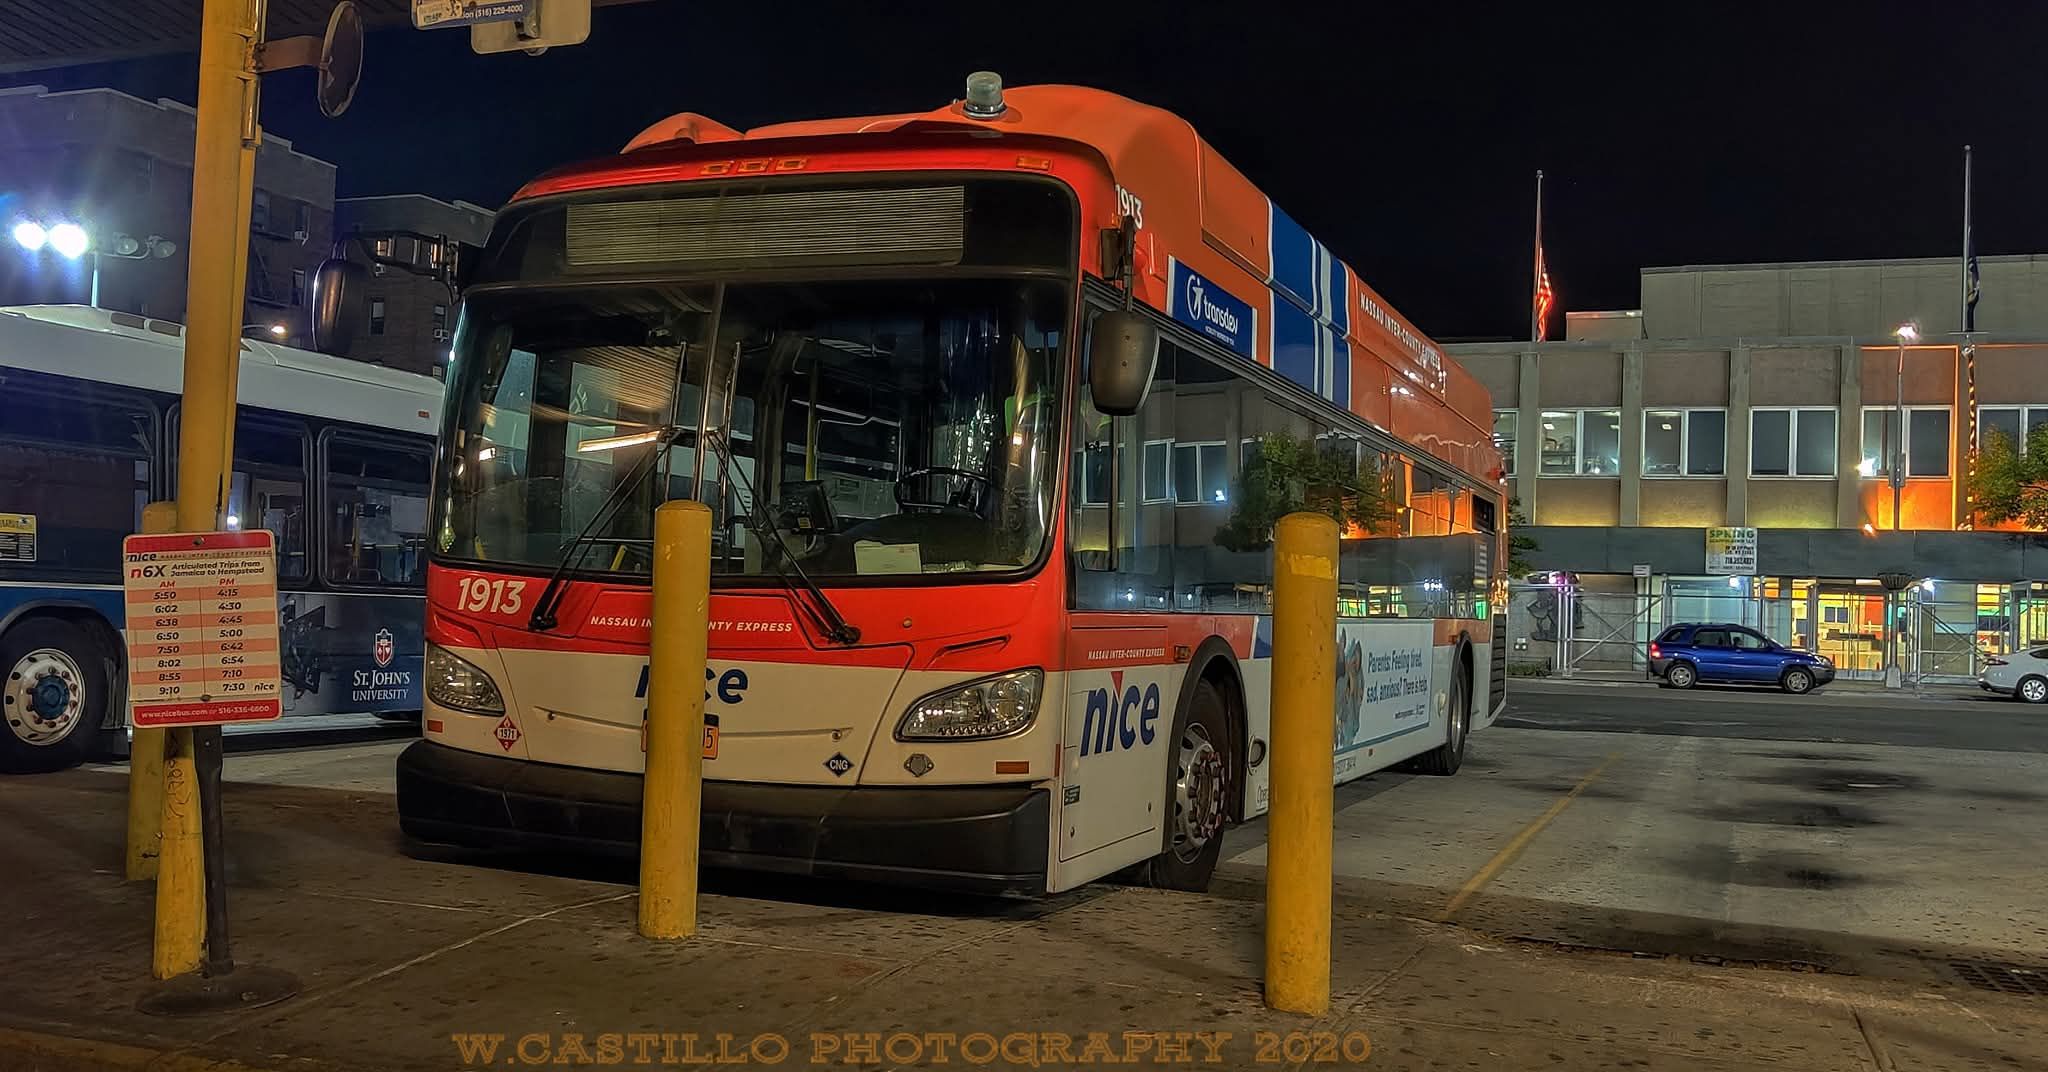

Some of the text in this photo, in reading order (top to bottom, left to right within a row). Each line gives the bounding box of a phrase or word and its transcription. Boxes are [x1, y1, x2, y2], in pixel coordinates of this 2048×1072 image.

[1115, 184, 1143, 230] 1913
[1360, 291, 1384, 326] NASSAU
[1203, 295, 1239, 335] transdev
[1709, 529, 1755, 538] SPRING
[127, 553, 157, 562] nice
[171, 560, 261, 570] Articulated Trips from
[130, 564, 167, 579] n6X
[217, 567, 264, 577] Hempstead
[219, 578, 235, 586] PM
[153, 591, 177, 600] 5:50
[217, 588, 238, 597] 4:15
[457, 577, 527, 615] 1913
[155, 605, 178, 614] 6:02
[218, 602, 241, 610] 4:30
[155, 618, 178, 627] 6:38
[218, 615, 243, 624] 4:45
[590, 616, 637, 627] NASSAU
[736, 621, 793, 633] EXPRESS
[156, 631, 179, 640] 6:50
[219, 629, 243, 638] 5:00
[158, 645, 180, 654] 7:50
[220, 642, 244, 651] 6:42
[1088, 648, 1165, 660] NASSAU INTER-COUNTY EXPRESS
[157, 659, 181, 668] 8:02
[221, 656, 244, 665] 6:54
[1392, 648, 1410, 674] Feeling
[158, 672, 181, 681] 8:55
[222, 669, 243, 678] 7:10
[353, 670, 410, 689] ST. JOHN'S
[159, 686, 180, 695] 9:10
[222, 683, 245, 692] 7:30
[253, 682, 275, 692] nice
[352, 689, 409, 702] UNIVERSITY
[141, 709, 208, 719] www.nicebus.com
[218, 706, 270, 715] 516-336-6600
[1080, 670, 1160, 757] nice
[499, 728, 515, 739] 1971
[830, 759, 848, 770] CNG
